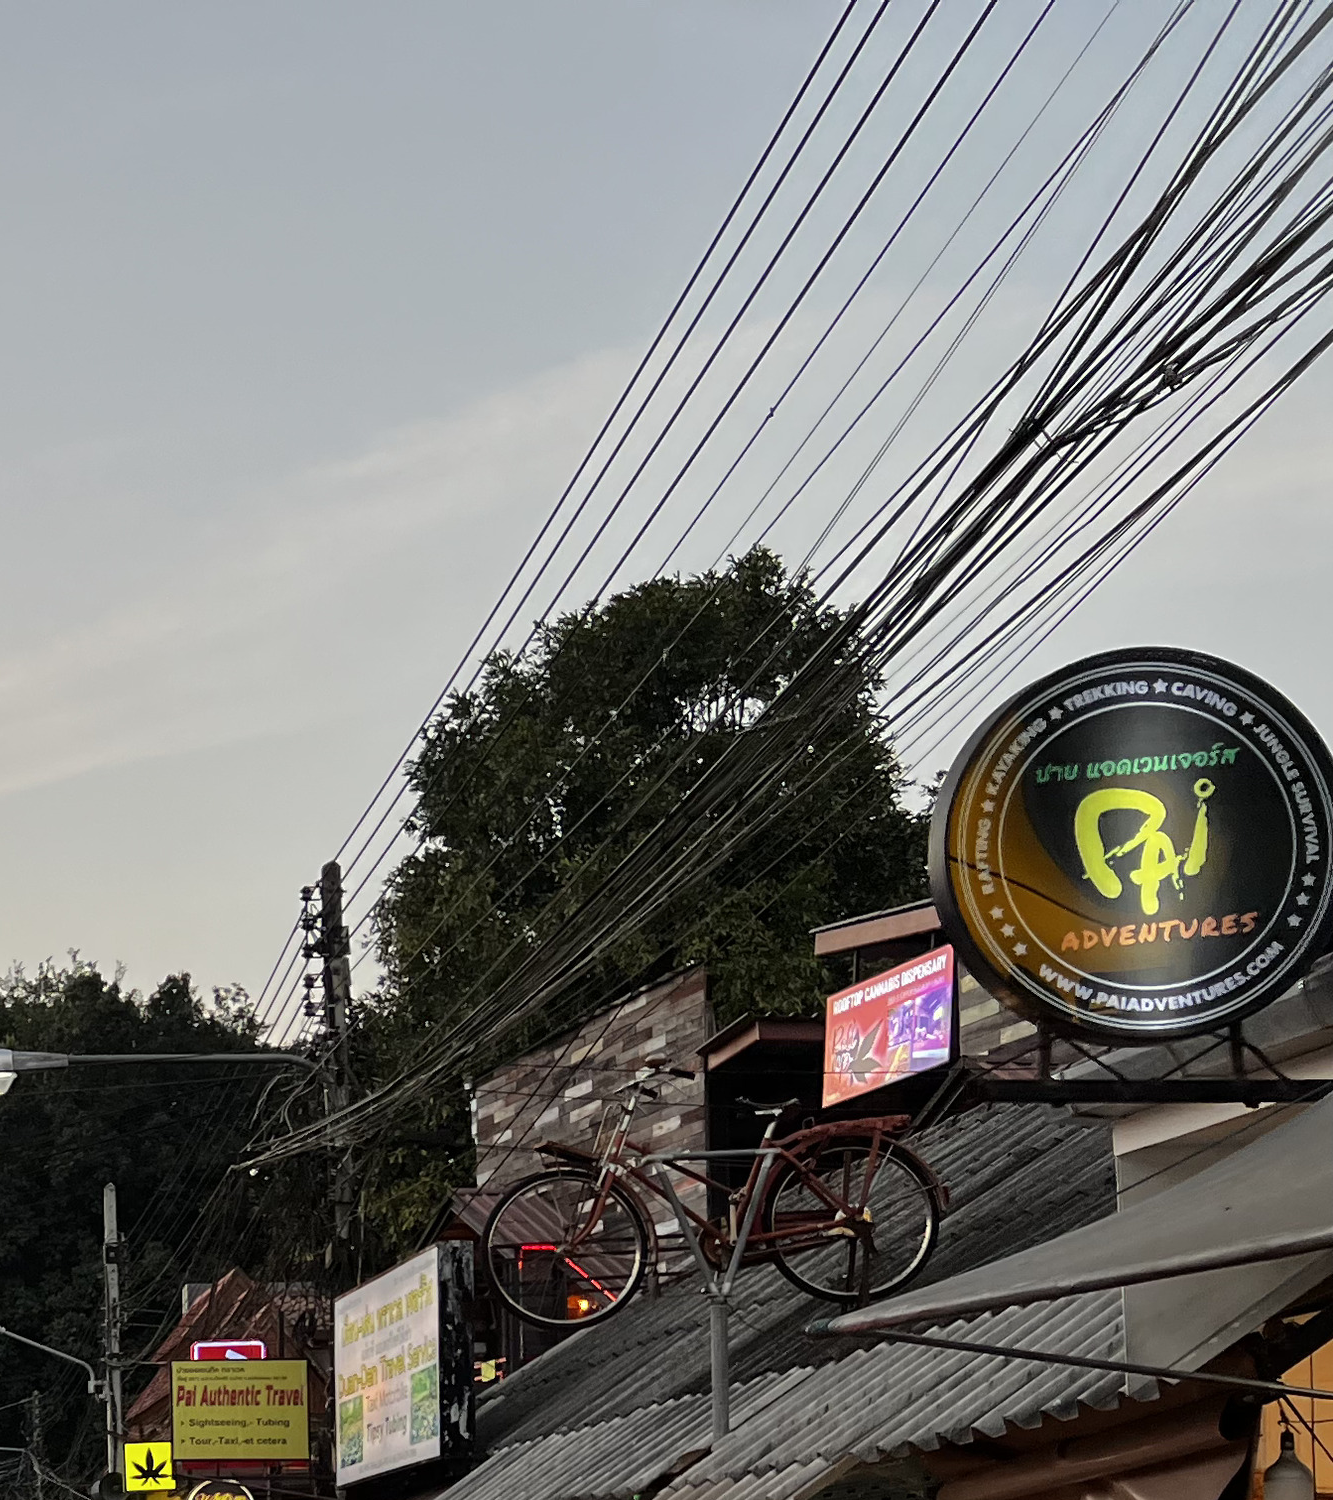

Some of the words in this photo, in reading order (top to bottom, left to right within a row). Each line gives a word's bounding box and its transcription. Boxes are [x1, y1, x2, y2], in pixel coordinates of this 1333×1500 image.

[985, 717, 1048, 796] KAYAKING
[1062, 680, 1150, 711] TREKKING
[1170, 681, 1239, 718] CAVING
[1252, 722, 1300, 782] JUNGLE
[1289, 776, 1321, 865] SURVIVAL
[974, 818, 997, 896] RAFTING
[1059, 911, 1259, 954] ADVENTURES
[833, 988, 864, 1016] ROOFTOP
[864, 974, 901, 1002] CANNABIS
[901, 953, 948, 989] DISPENSARY
[1038, 941, 1287, 1014] WWW.PAIADVENTURES.COM
[176, 1384, 197, 1407] Pai
[199, 1384, 262, 1407] Authentic
[265, 1384, 305, 1407] Travel
[338, 1363, 379, 1399] Duan-Den
[379, 1345, 406, 1383] Travel
[256, 1417, 291, 1428] Tubing
[256, 1436, 288, 1445] cetera
[385, 1412, 408, 1436] Tubing
